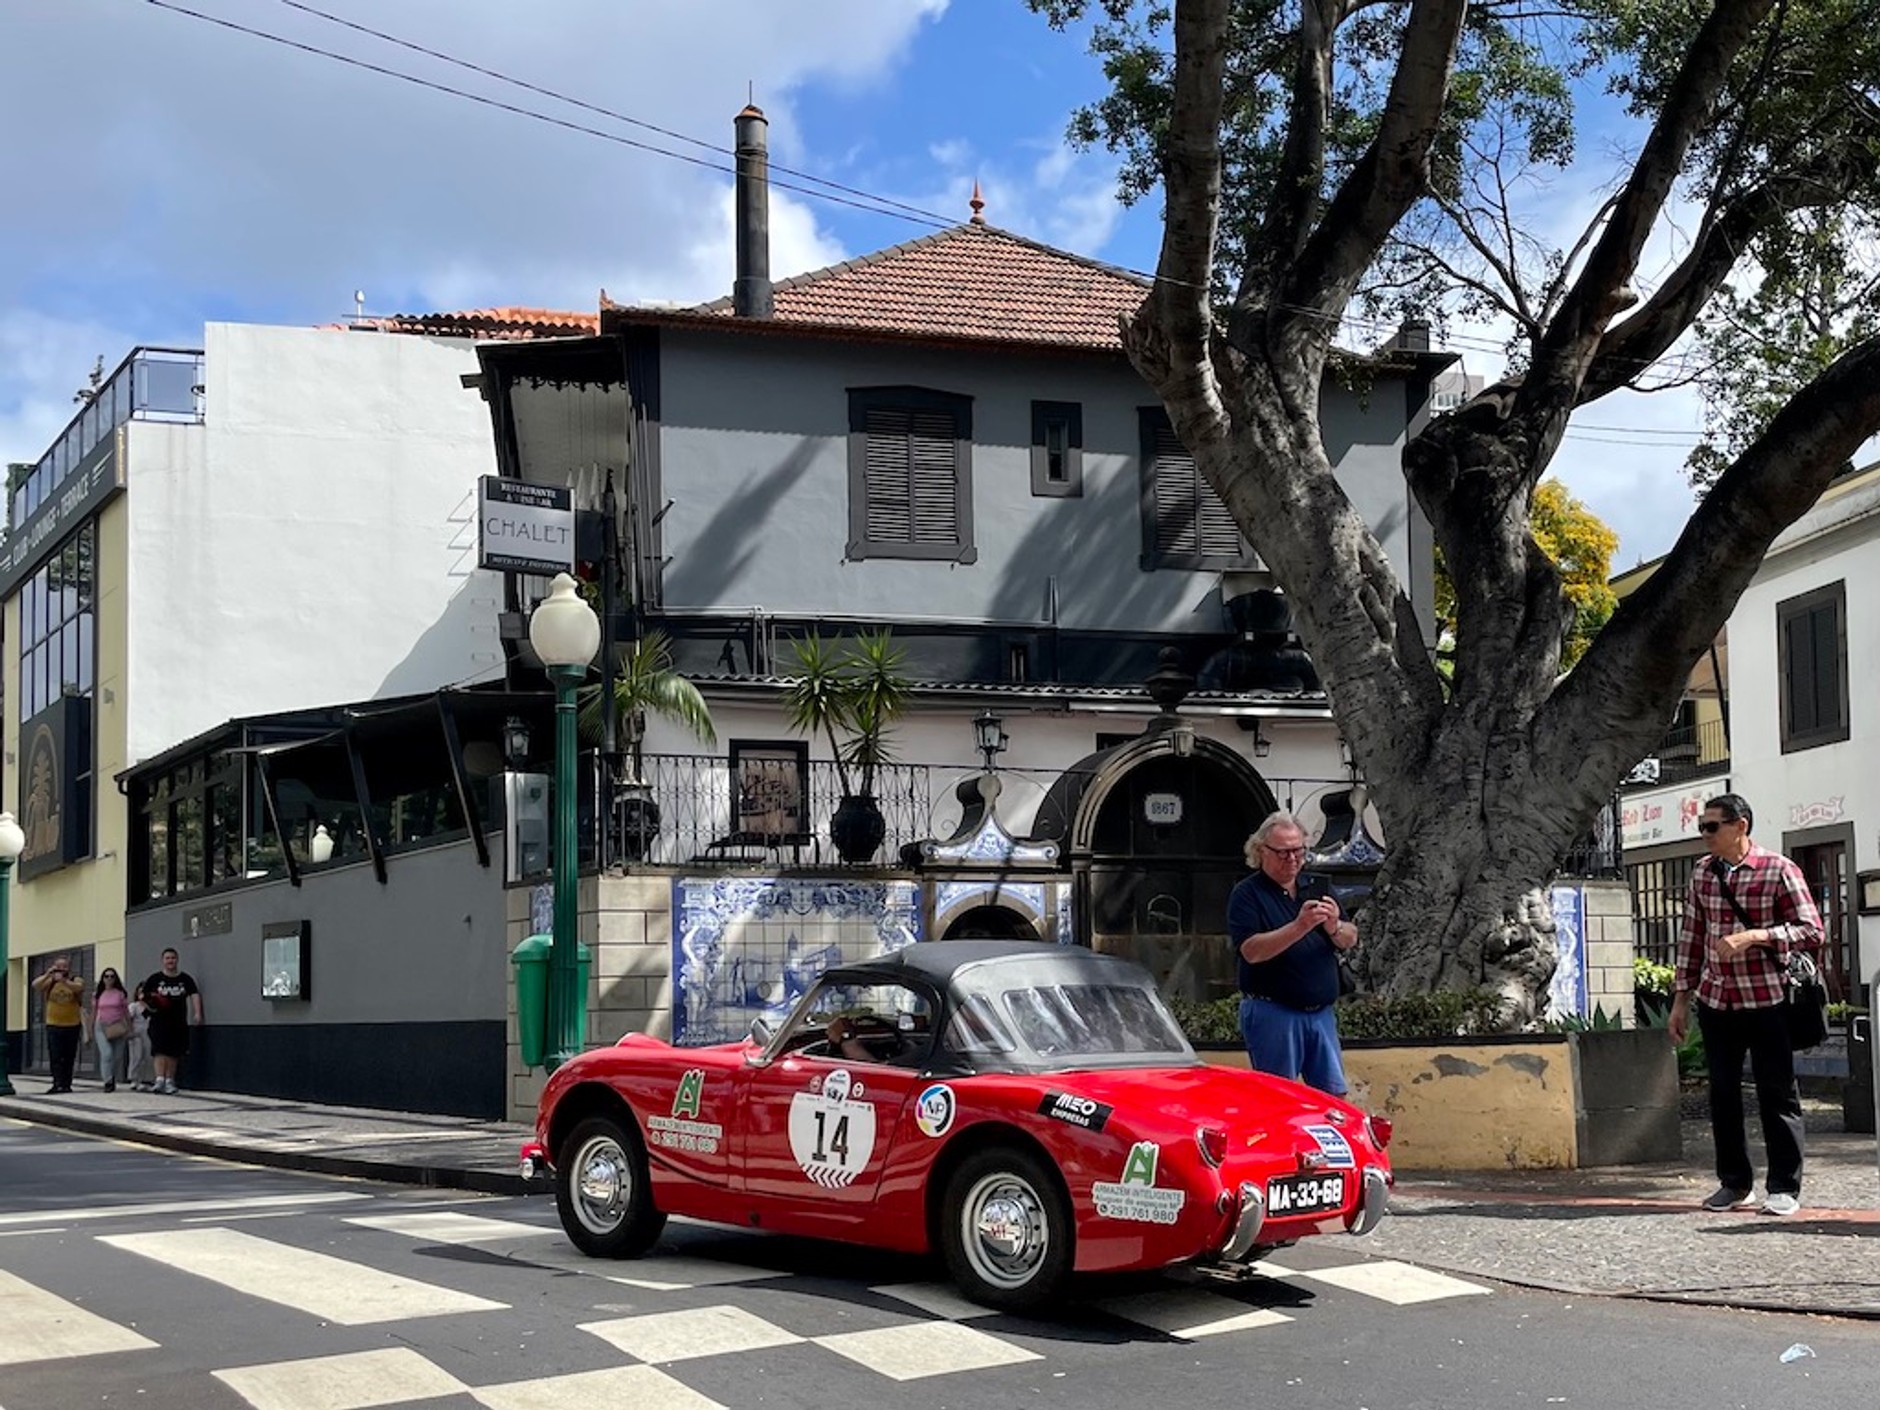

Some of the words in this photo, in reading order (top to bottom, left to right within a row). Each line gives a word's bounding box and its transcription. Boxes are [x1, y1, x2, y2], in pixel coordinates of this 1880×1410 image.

[500, 482, 557, 499] RESTAURANTE
[31, 505, 57, 549] LOUNGE
[60, 472, 90, 520] TERRACE
[486, 517, 571, 545] CHALET
[1055, 1092, 1098, 1116] MEO
[1050, 1107, 1090, 1127] EMPRESAS
[812, 1110, 850, 1166] 14
[1095, 1194, 1123, 1204] Aluguer
[1125, 1197, 1134, 1205] de
[1136, 1200, 1168, 1210] espaços
[1131, 1188, 1182, 1201] INTELIGENTE
[1268, 1178, 1344, 1211] MA-33-68
[1110, 1205, 1129, 1216] 291
[1131, 1208, 1149, 1219] 761
[1152, 1210, 1175, 1222] 980
